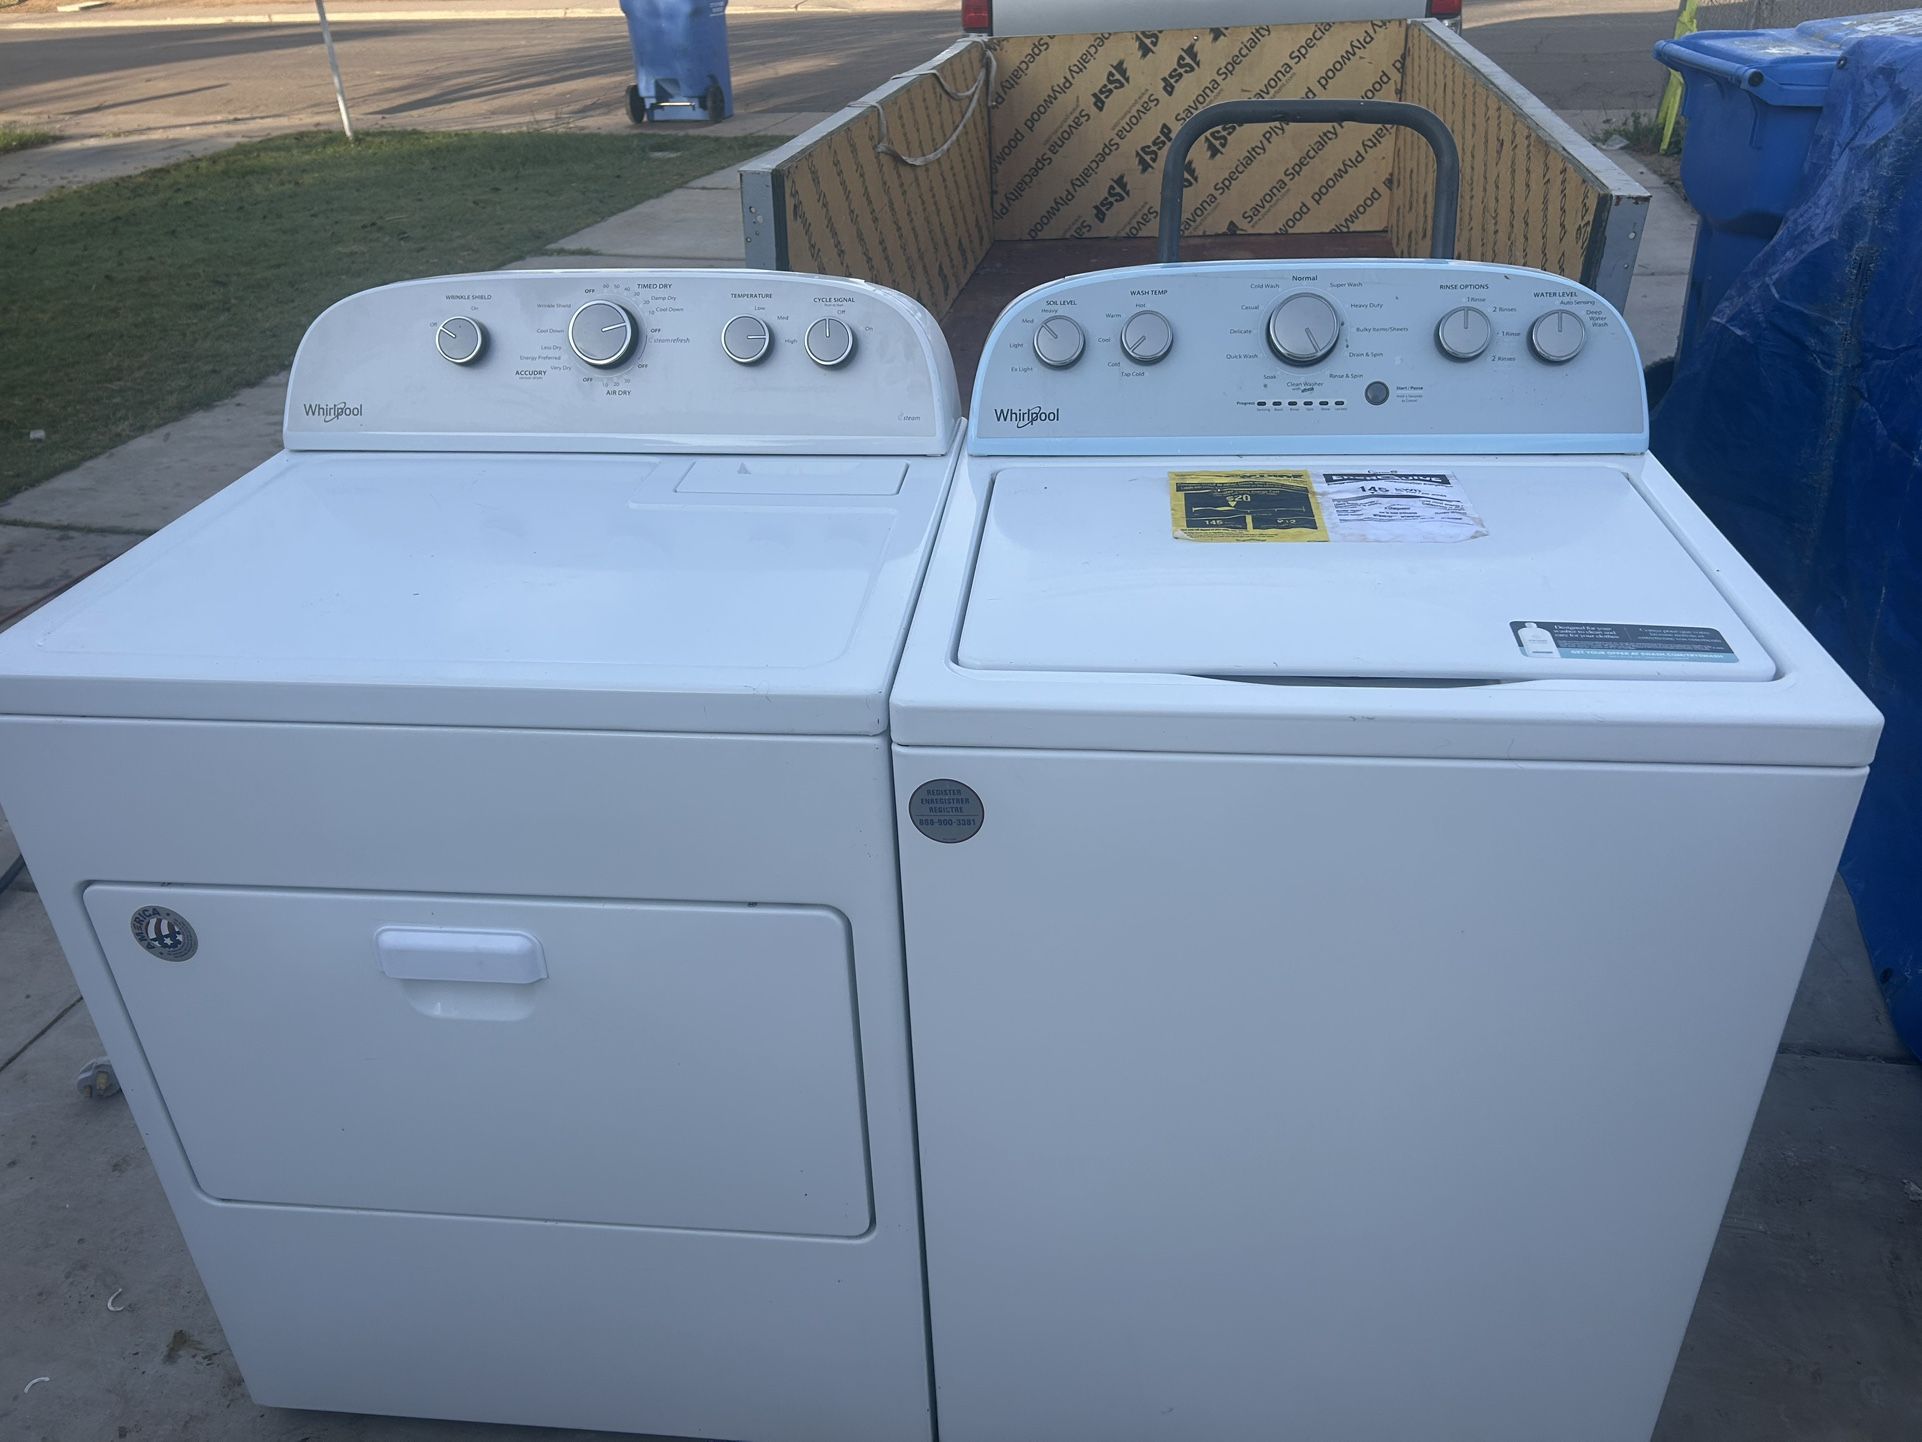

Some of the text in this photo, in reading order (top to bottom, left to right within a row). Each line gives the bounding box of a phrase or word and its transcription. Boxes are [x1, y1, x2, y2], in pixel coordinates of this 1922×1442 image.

[1001, 37, 1049, 94] Specialty
[1175, 79, 1222, 121] Savona
[1216, 25, 1271, 81] Specialty
[1248, 62, 1294, 99] avona
[1317, 30, 1374, 90] Plywood
[1025, 76, 1073, 132] Plywood
[1116, 94, 1160, 140] Savona
[1048, 109, 1090, 154] Savona
[1006, 153, 1052, 203] Specialty
[1071, 138, 1119, 192] Specialty
[1214, 140, 1266, 195] Specialty
[1242, 179, 1287, 223] Savona
[1284, 126, 1338, 181] Specialty
[1311, 150, 1365, 205] Plywood
[303, 402, 363, 422] Whirlpool
[994, 406, 1059, 428] Whirlpool
